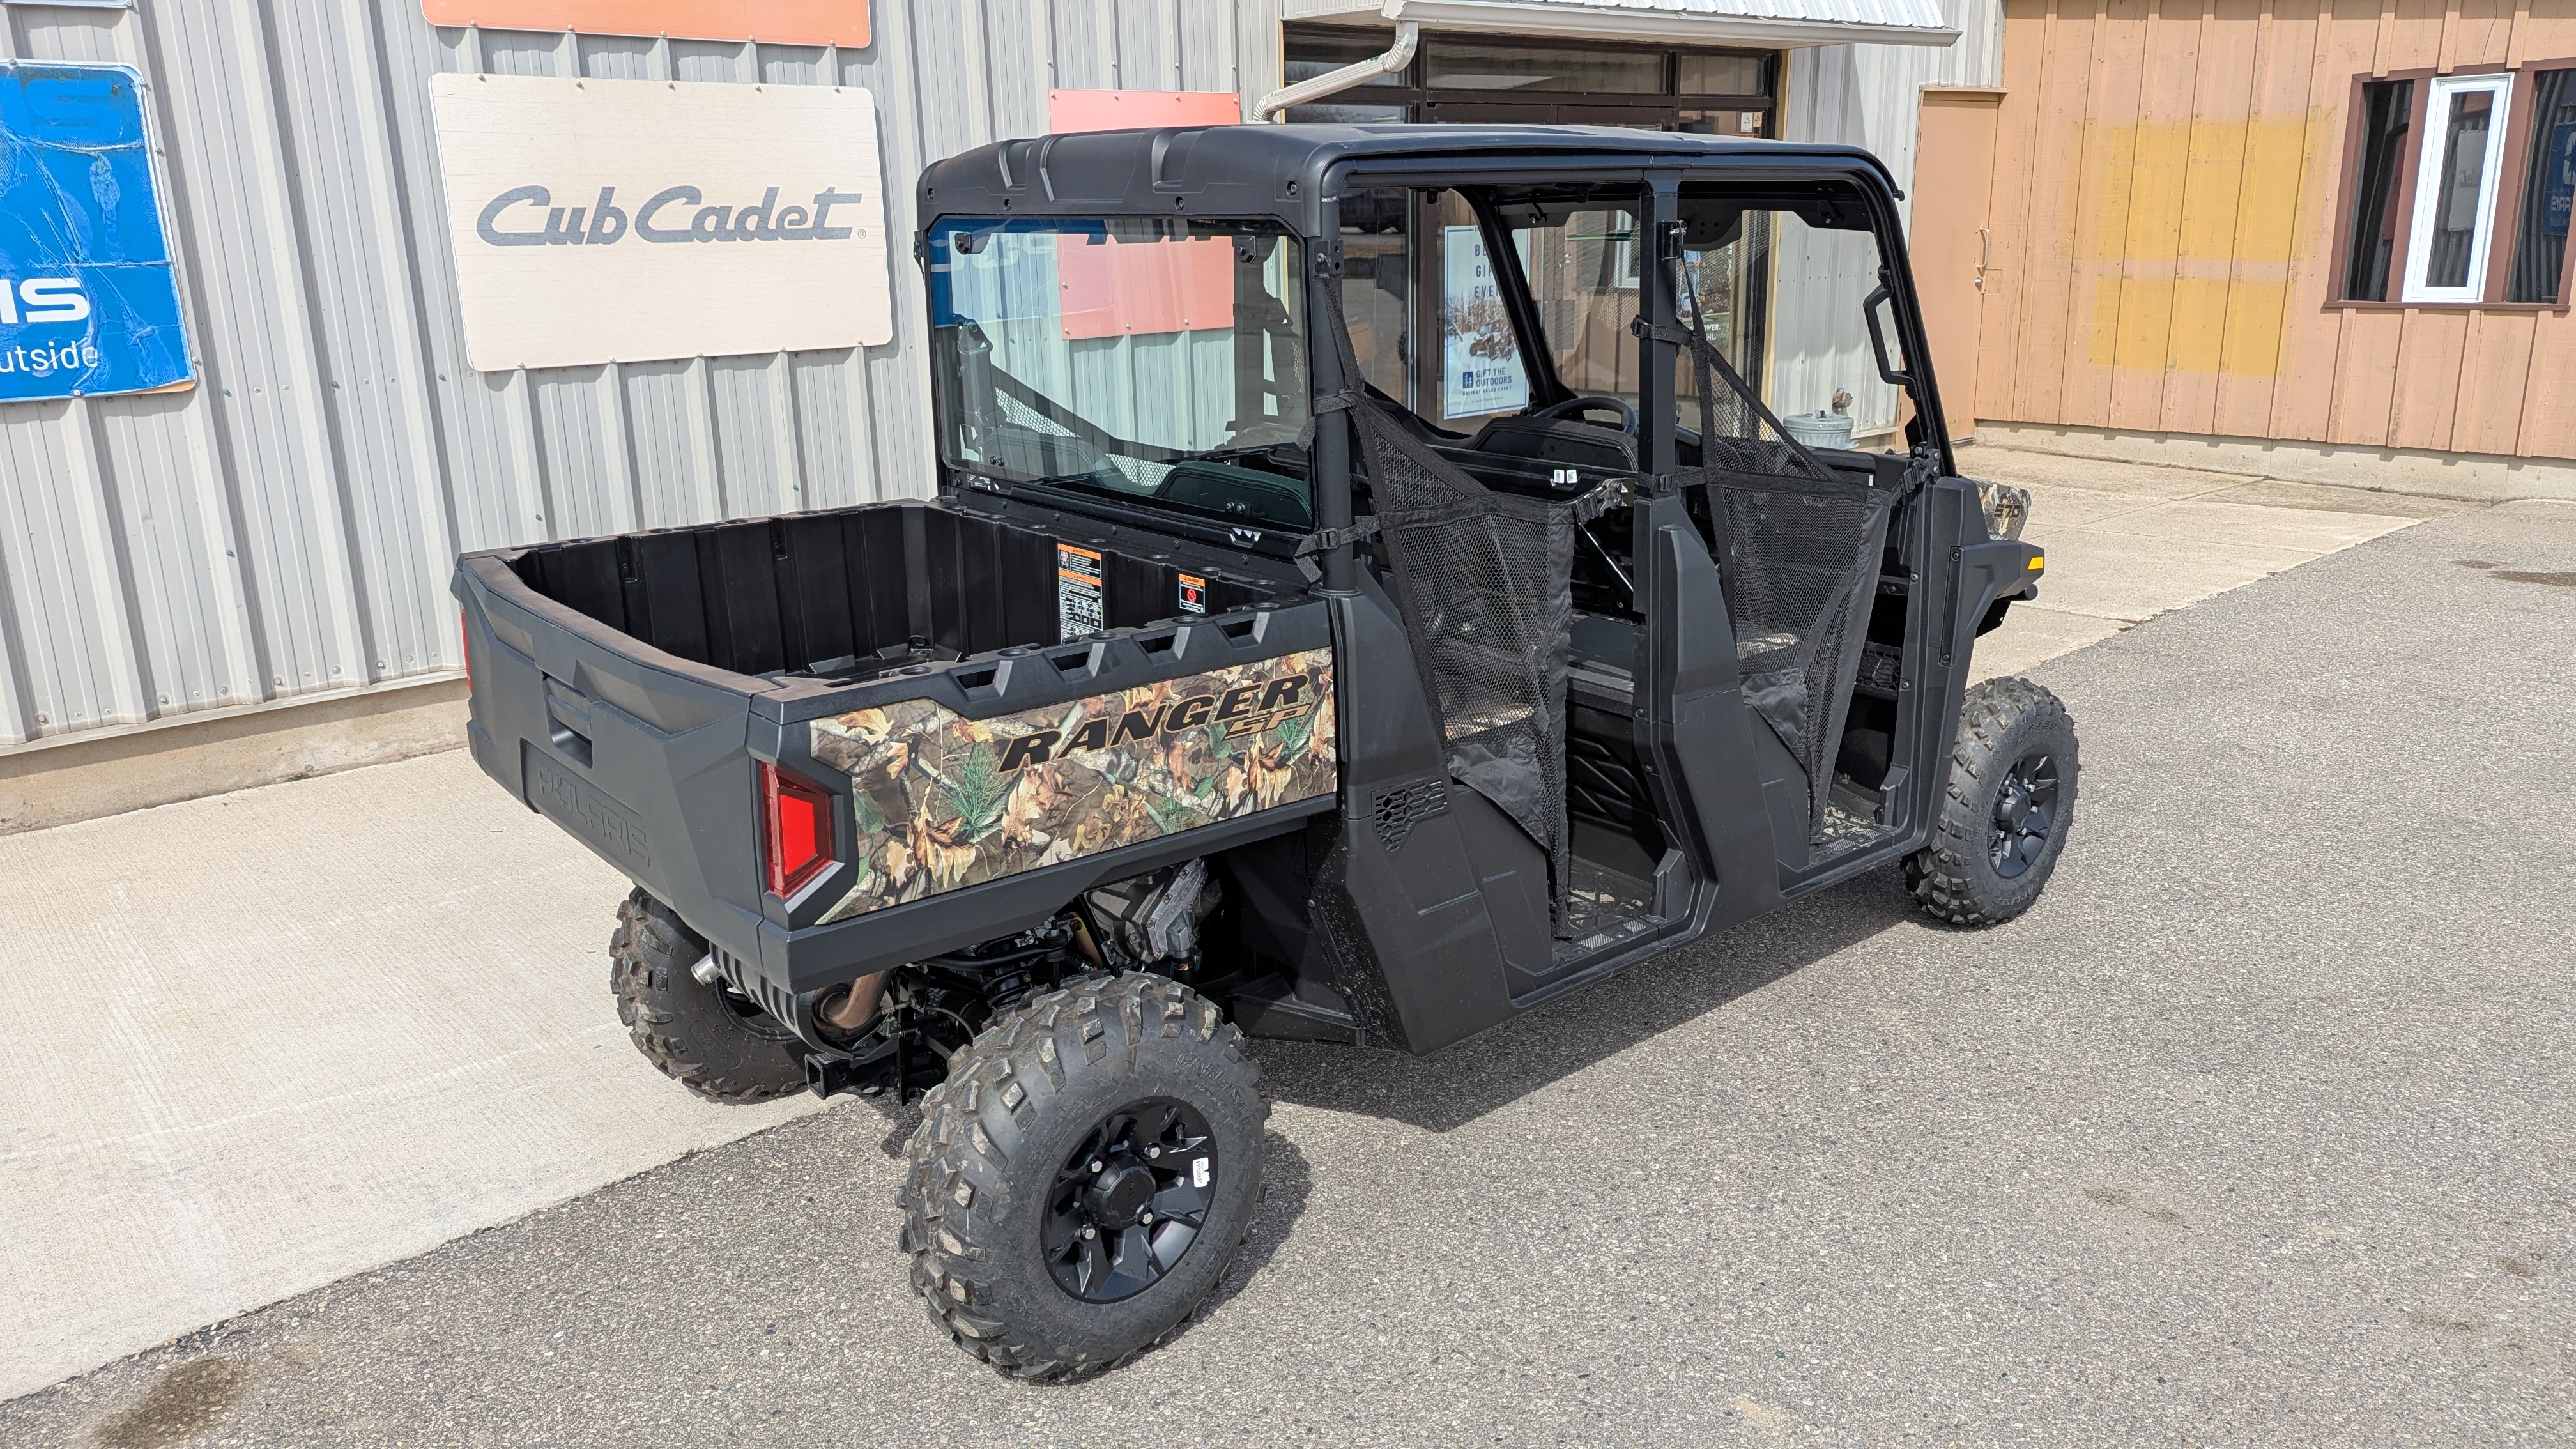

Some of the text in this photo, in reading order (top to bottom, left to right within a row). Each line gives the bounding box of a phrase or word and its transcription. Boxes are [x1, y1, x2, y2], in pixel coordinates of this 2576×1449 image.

[476, 185, 864, 246] Cub Cadet
[1476, 367, 1506, 378] GIFT THE
[1476, 375, 1512, 387] OUTDOORS
[1993, 503, 2021, 519] 570
[997, 673, 1309, 774] RANGER
[1223, 702, 1313, 742] SP
[538, 763, 651, 868] POLARIS
